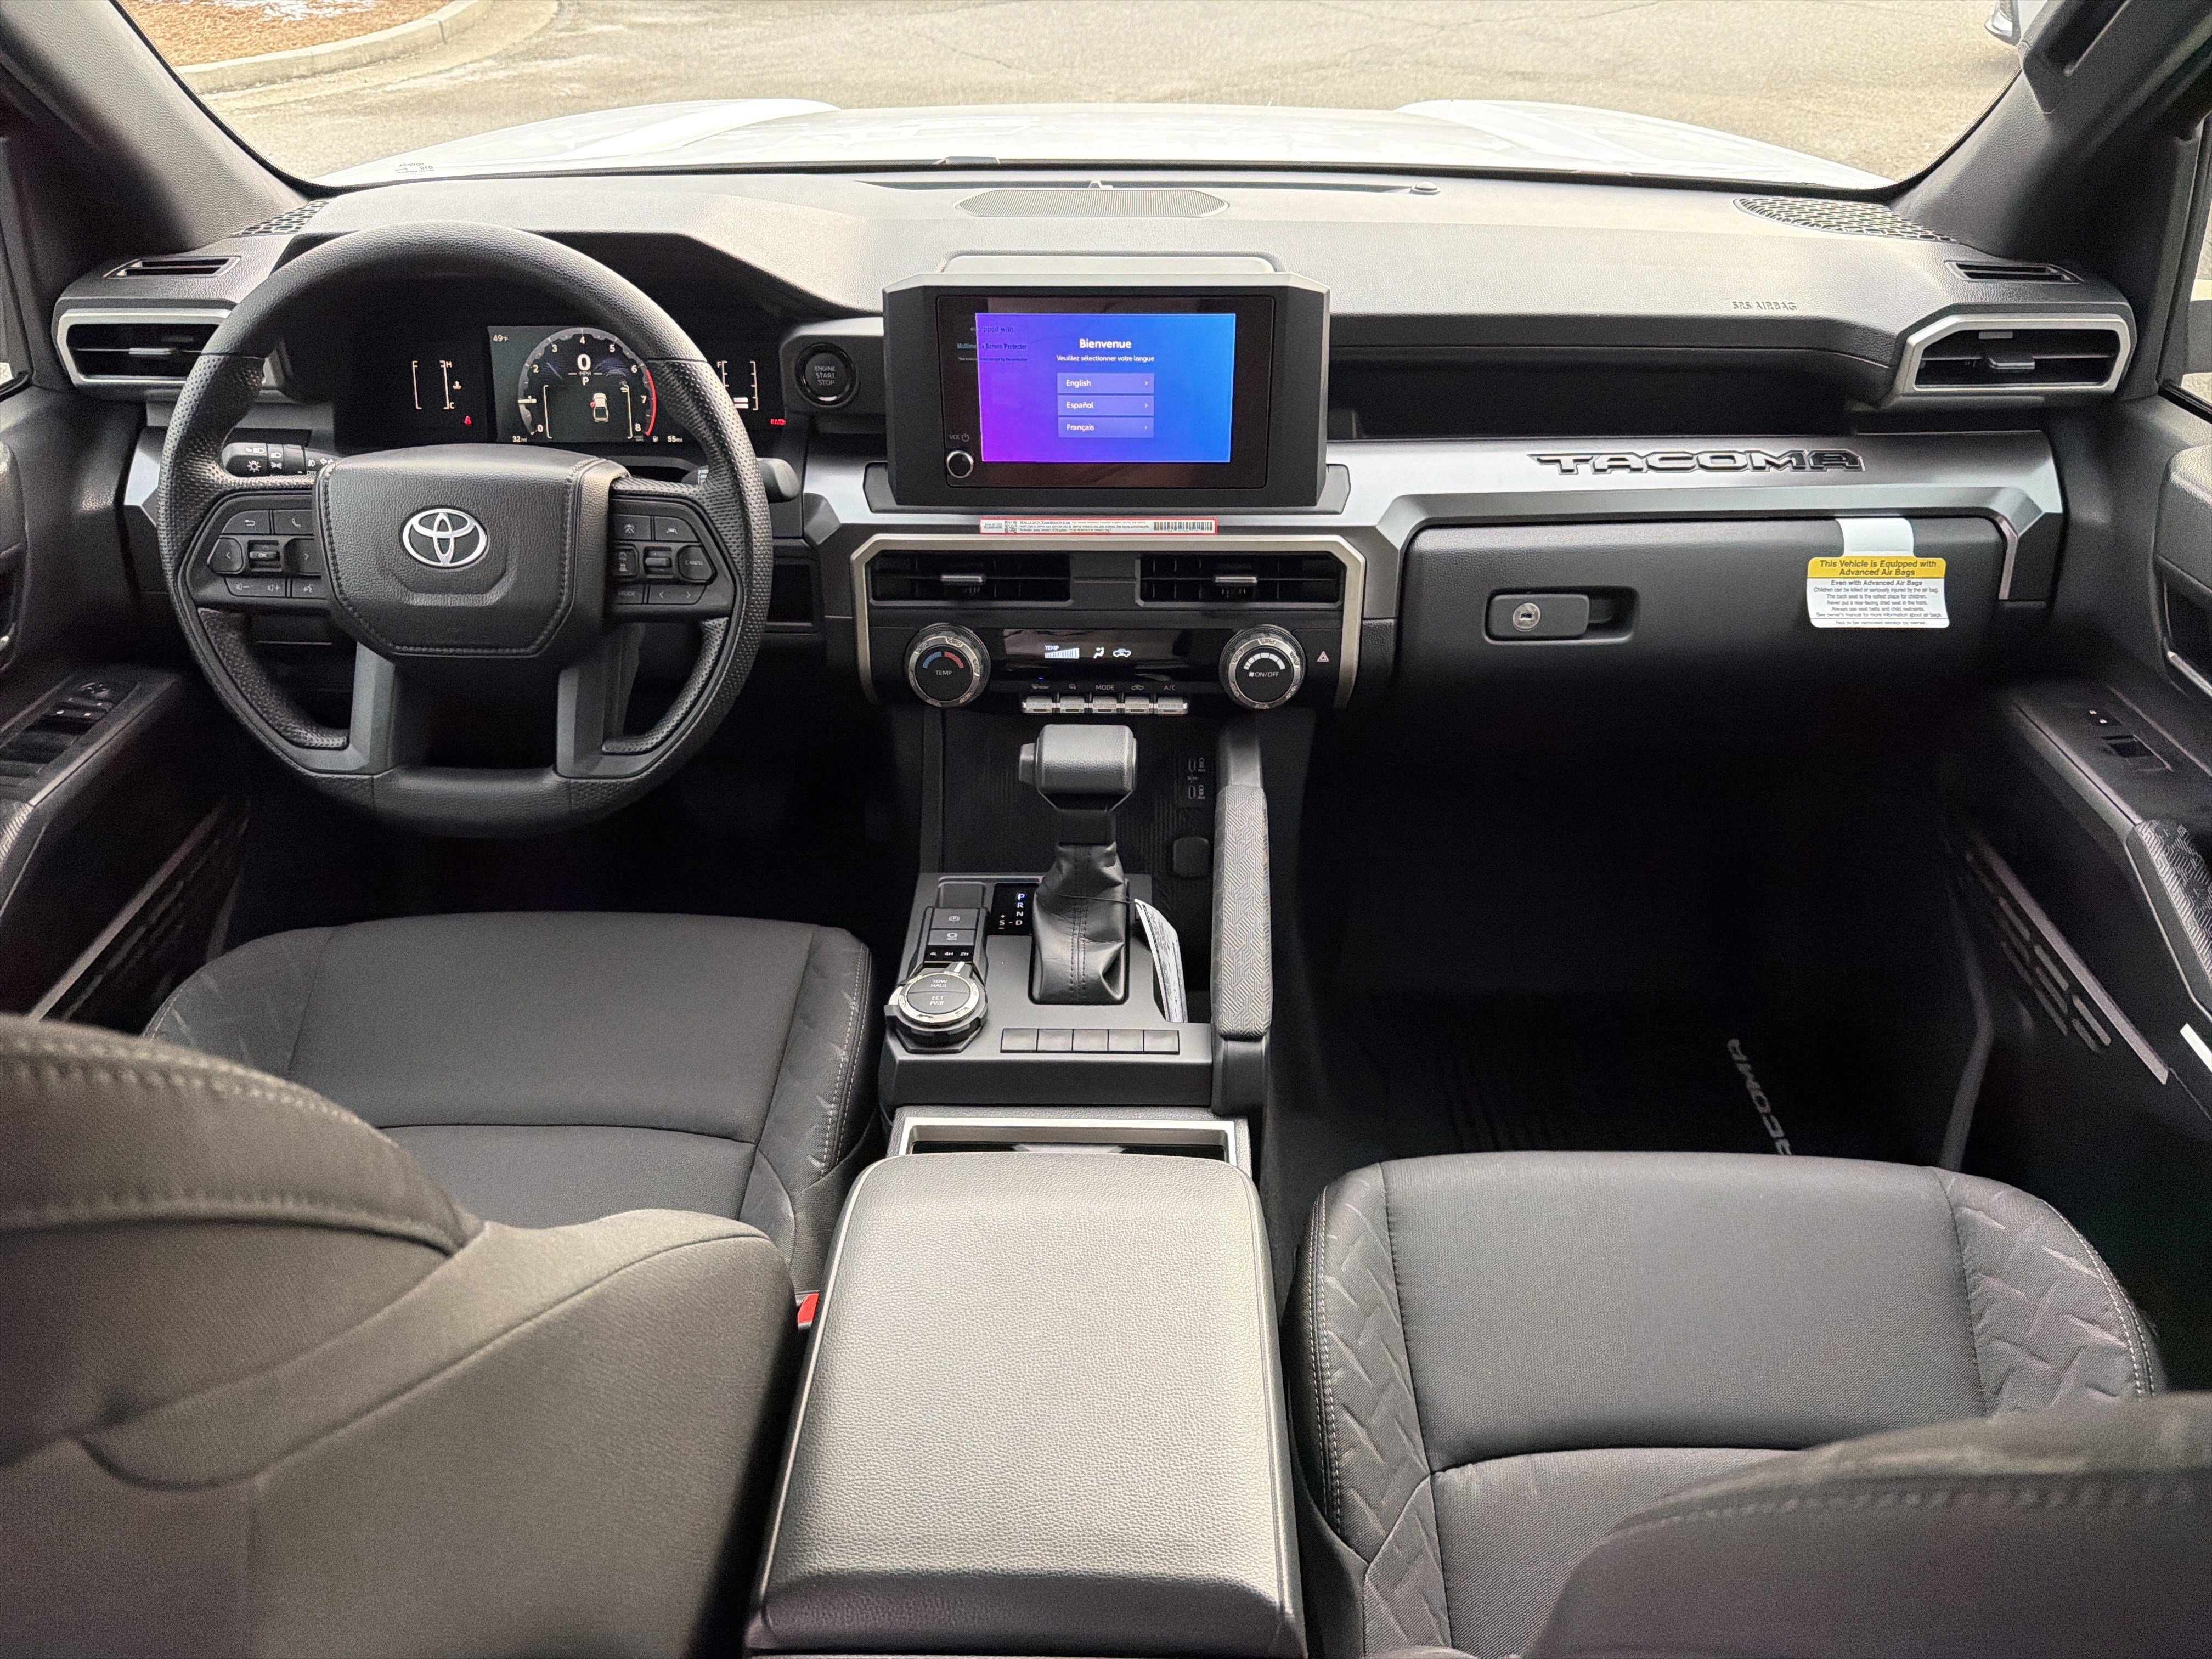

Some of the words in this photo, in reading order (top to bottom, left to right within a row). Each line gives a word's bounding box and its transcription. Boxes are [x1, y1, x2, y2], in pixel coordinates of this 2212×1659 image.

[1732, 301, 1752, 309] SRS
[1756, 302, 1797, 311] AIRBAG
[579, 336, 585, 345] 4
[1079, 338, 1132, 348] Bienvenue
[610, 344, 616, 352] 5
[577, 354, 591, 371] 0
[631, 365, 637, 373] 6
[583, 377, 589, 386] P
[1066, 380, 1092, 388] English
[1066, 402, 1094, 410] Español
[635, 423, 641, 431] 8
[1526, 450, 1865, 475] TACOMA
[1880, 560, 1918, 569] Equipped
[1895, 569, 1915, 577] Bags
